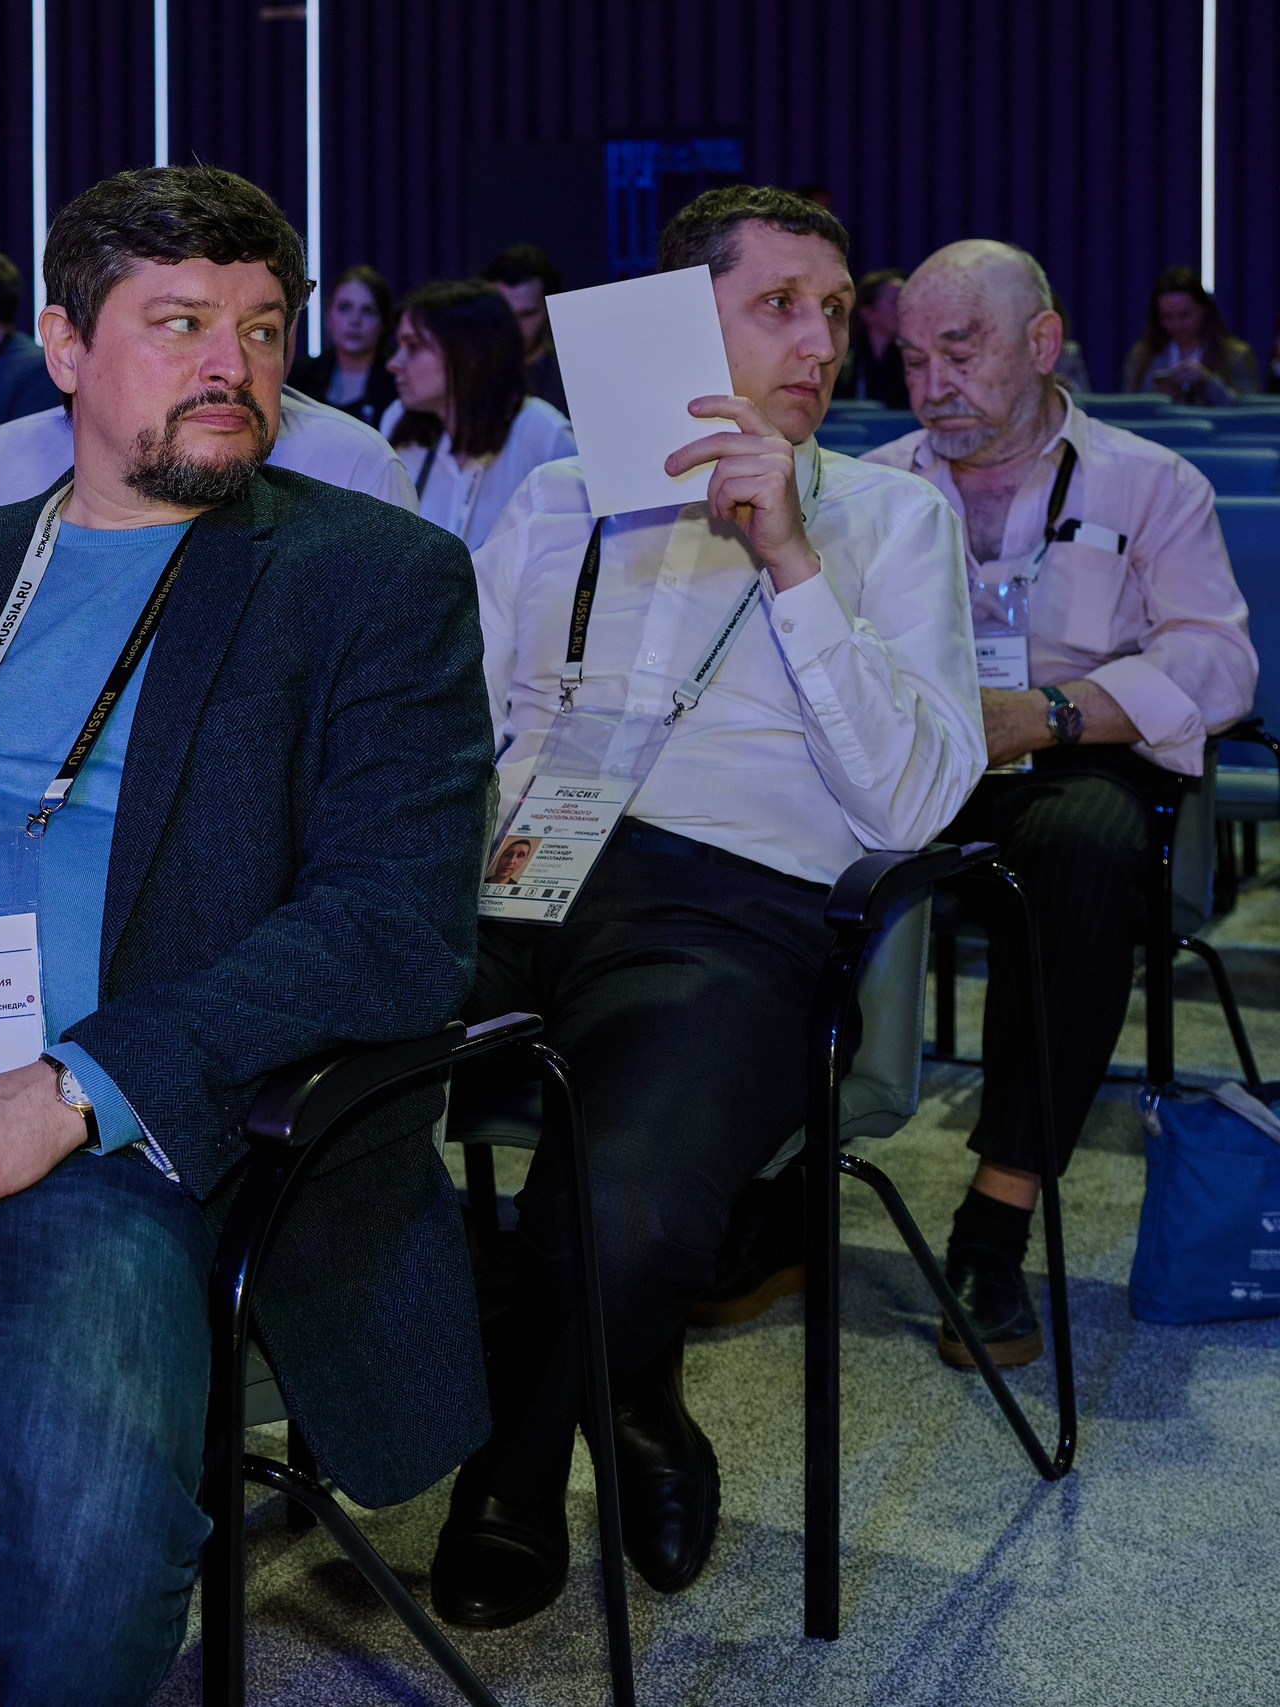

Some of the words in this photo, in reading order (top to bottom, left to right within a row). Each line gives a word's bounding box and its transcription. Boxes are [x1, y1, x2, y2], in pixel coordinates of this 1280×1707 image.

[121, 593, 166, 668] ВЫСТАВКА-ФОРУМ
[571, 590, 590, 654] RUSSIA.RU
[694, 628, 731, 683] МЕЖДУНАРОДНАЯ
[68, 692, 116, 766] RUSSIA.RU
[530, 814, 599, 822] НЕДРОПОЛЬЗОВАНИЯ
[544, 808, 592, 816] РОССИЙСКОГО
[555, 789, 601, 799] РОССИЯ
